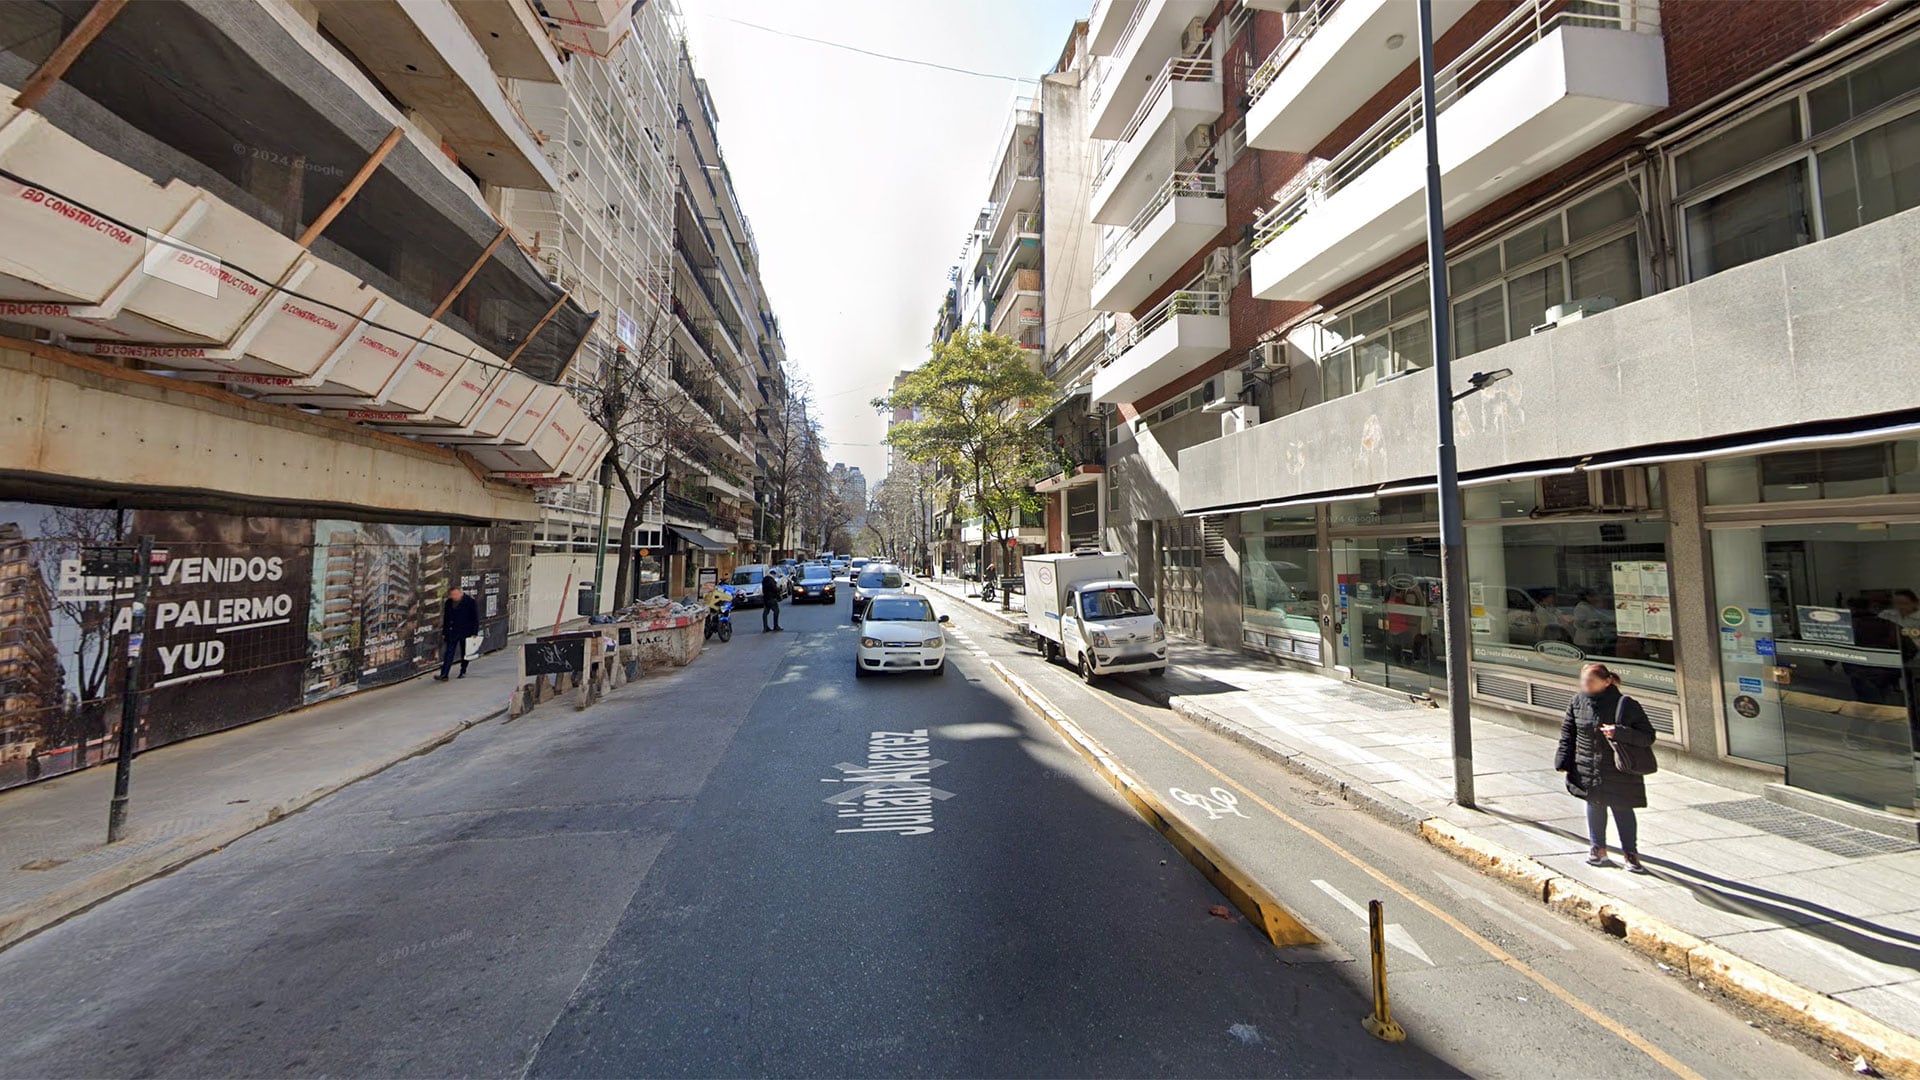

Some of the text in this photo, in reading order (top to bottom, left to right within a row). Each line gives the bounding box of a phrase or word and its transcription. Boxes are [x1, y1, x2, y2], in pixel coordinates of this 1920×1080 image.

[22, 188, 133, 244] BD CONSTRUCTORA
[177, 253, 257, 296] BD CONSTRUCTORA
[288, 306, 338, 331] CONSTRUCTORA
[95, 344, 206, 358] BD CONSTRUCTORA
[357, 411, 409, 420] CONSTRUCTORA
[59, 556, 283, 590] BVENIDOS
[155, 594, 293, 630] PALERMO
[157, 640, 226, 675] YUD
